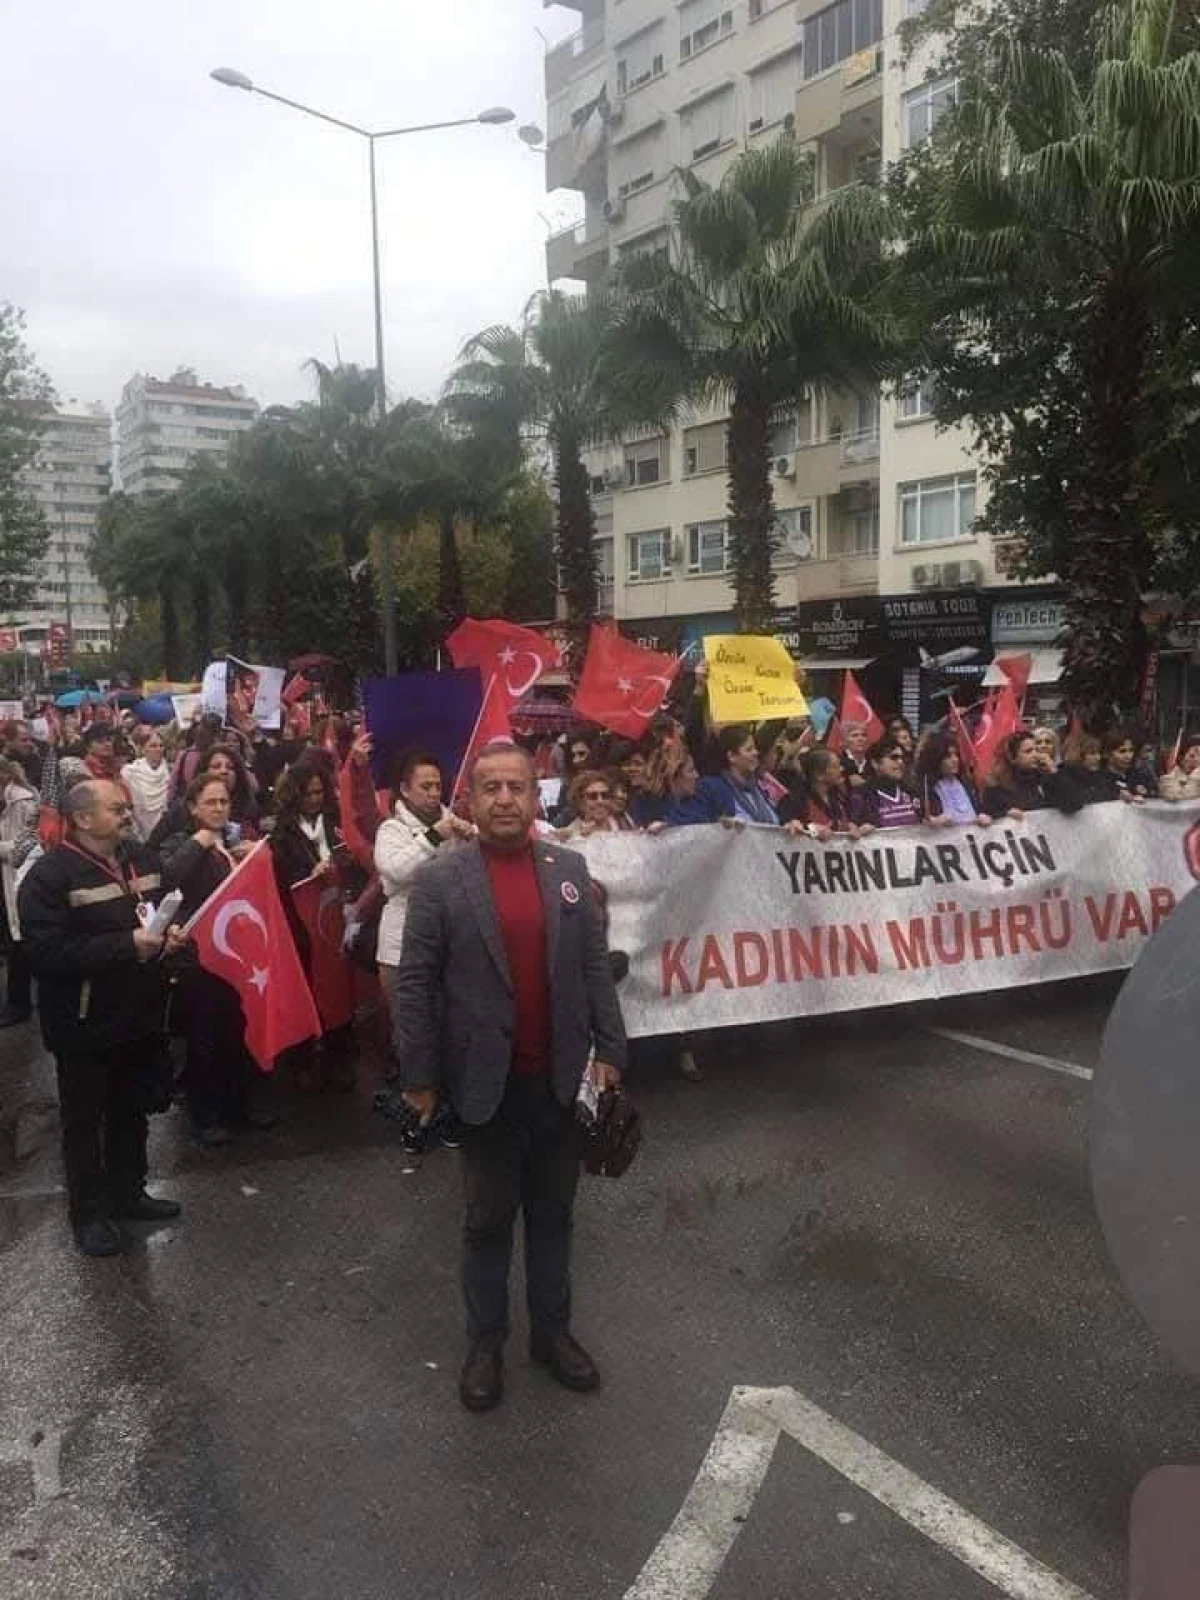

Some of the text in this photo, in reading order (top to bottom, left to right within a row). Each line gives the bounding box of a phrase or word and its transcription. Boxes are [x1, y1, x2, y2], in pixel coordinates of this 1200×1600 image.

[776, 830, 1056, 894] YARINLAR İÇİN
[661, 923, 878, 997] KADININ
[886, 887, 1071, 970] MÜHRÜ
